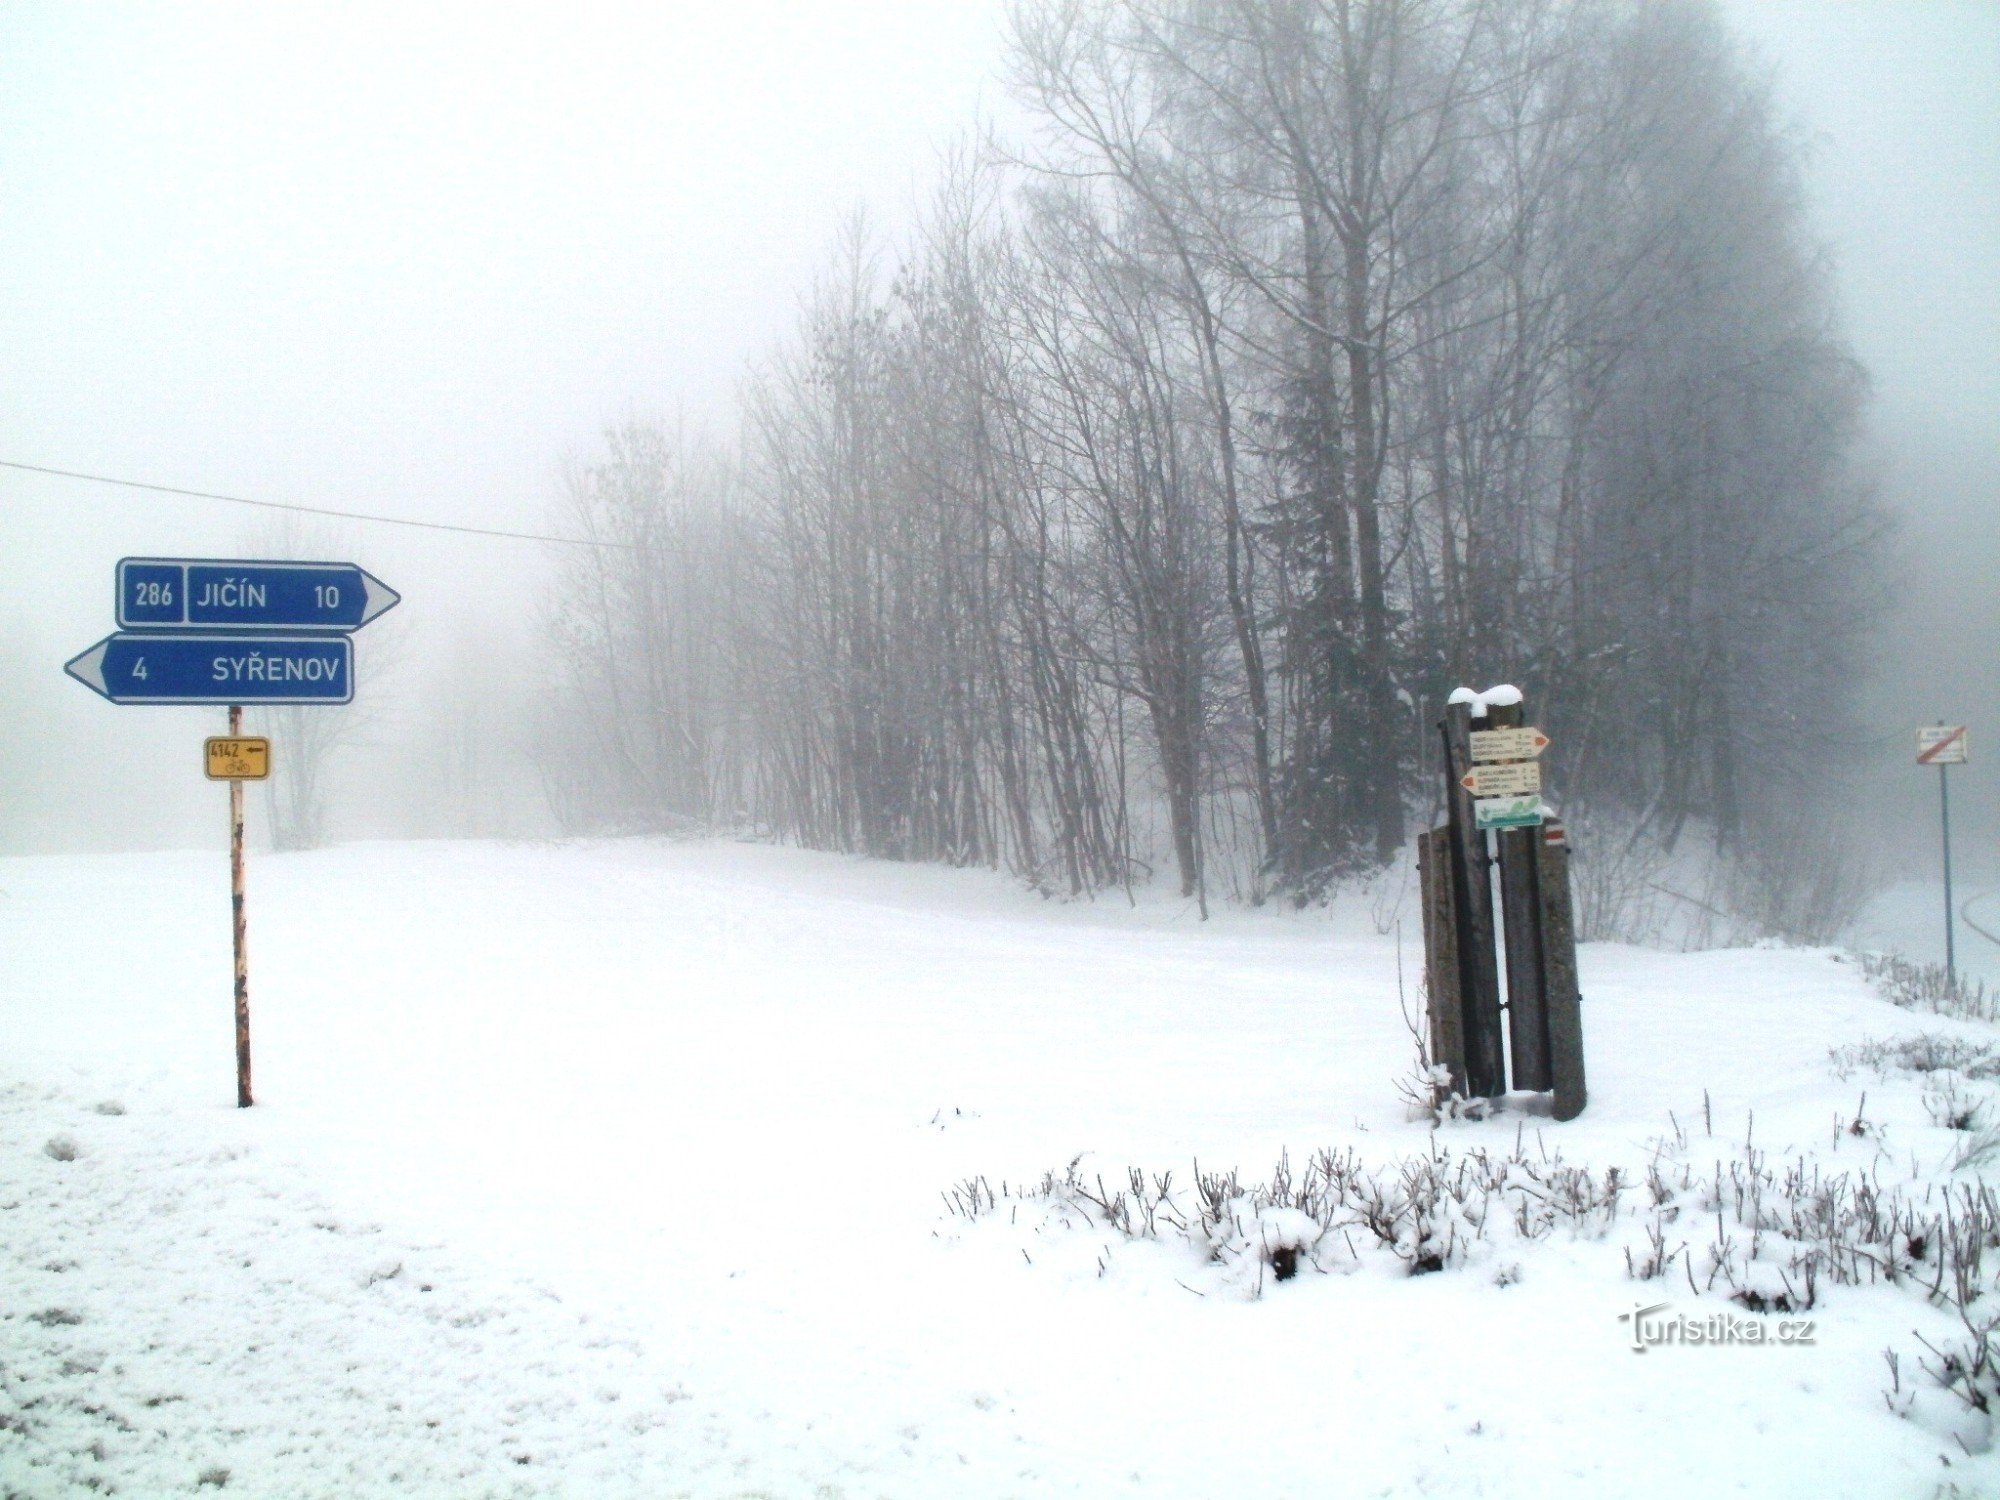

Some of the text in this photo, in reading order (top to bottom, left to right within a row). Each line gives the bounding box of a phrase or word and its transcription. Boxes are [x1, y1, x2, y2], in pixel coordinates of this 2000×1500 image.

[136, 578, 340, 608] 286 JIČÍN 10
[132, 652, 339, 680] 4 SYŘENOV
[210, 743, 239, 758] 4142
